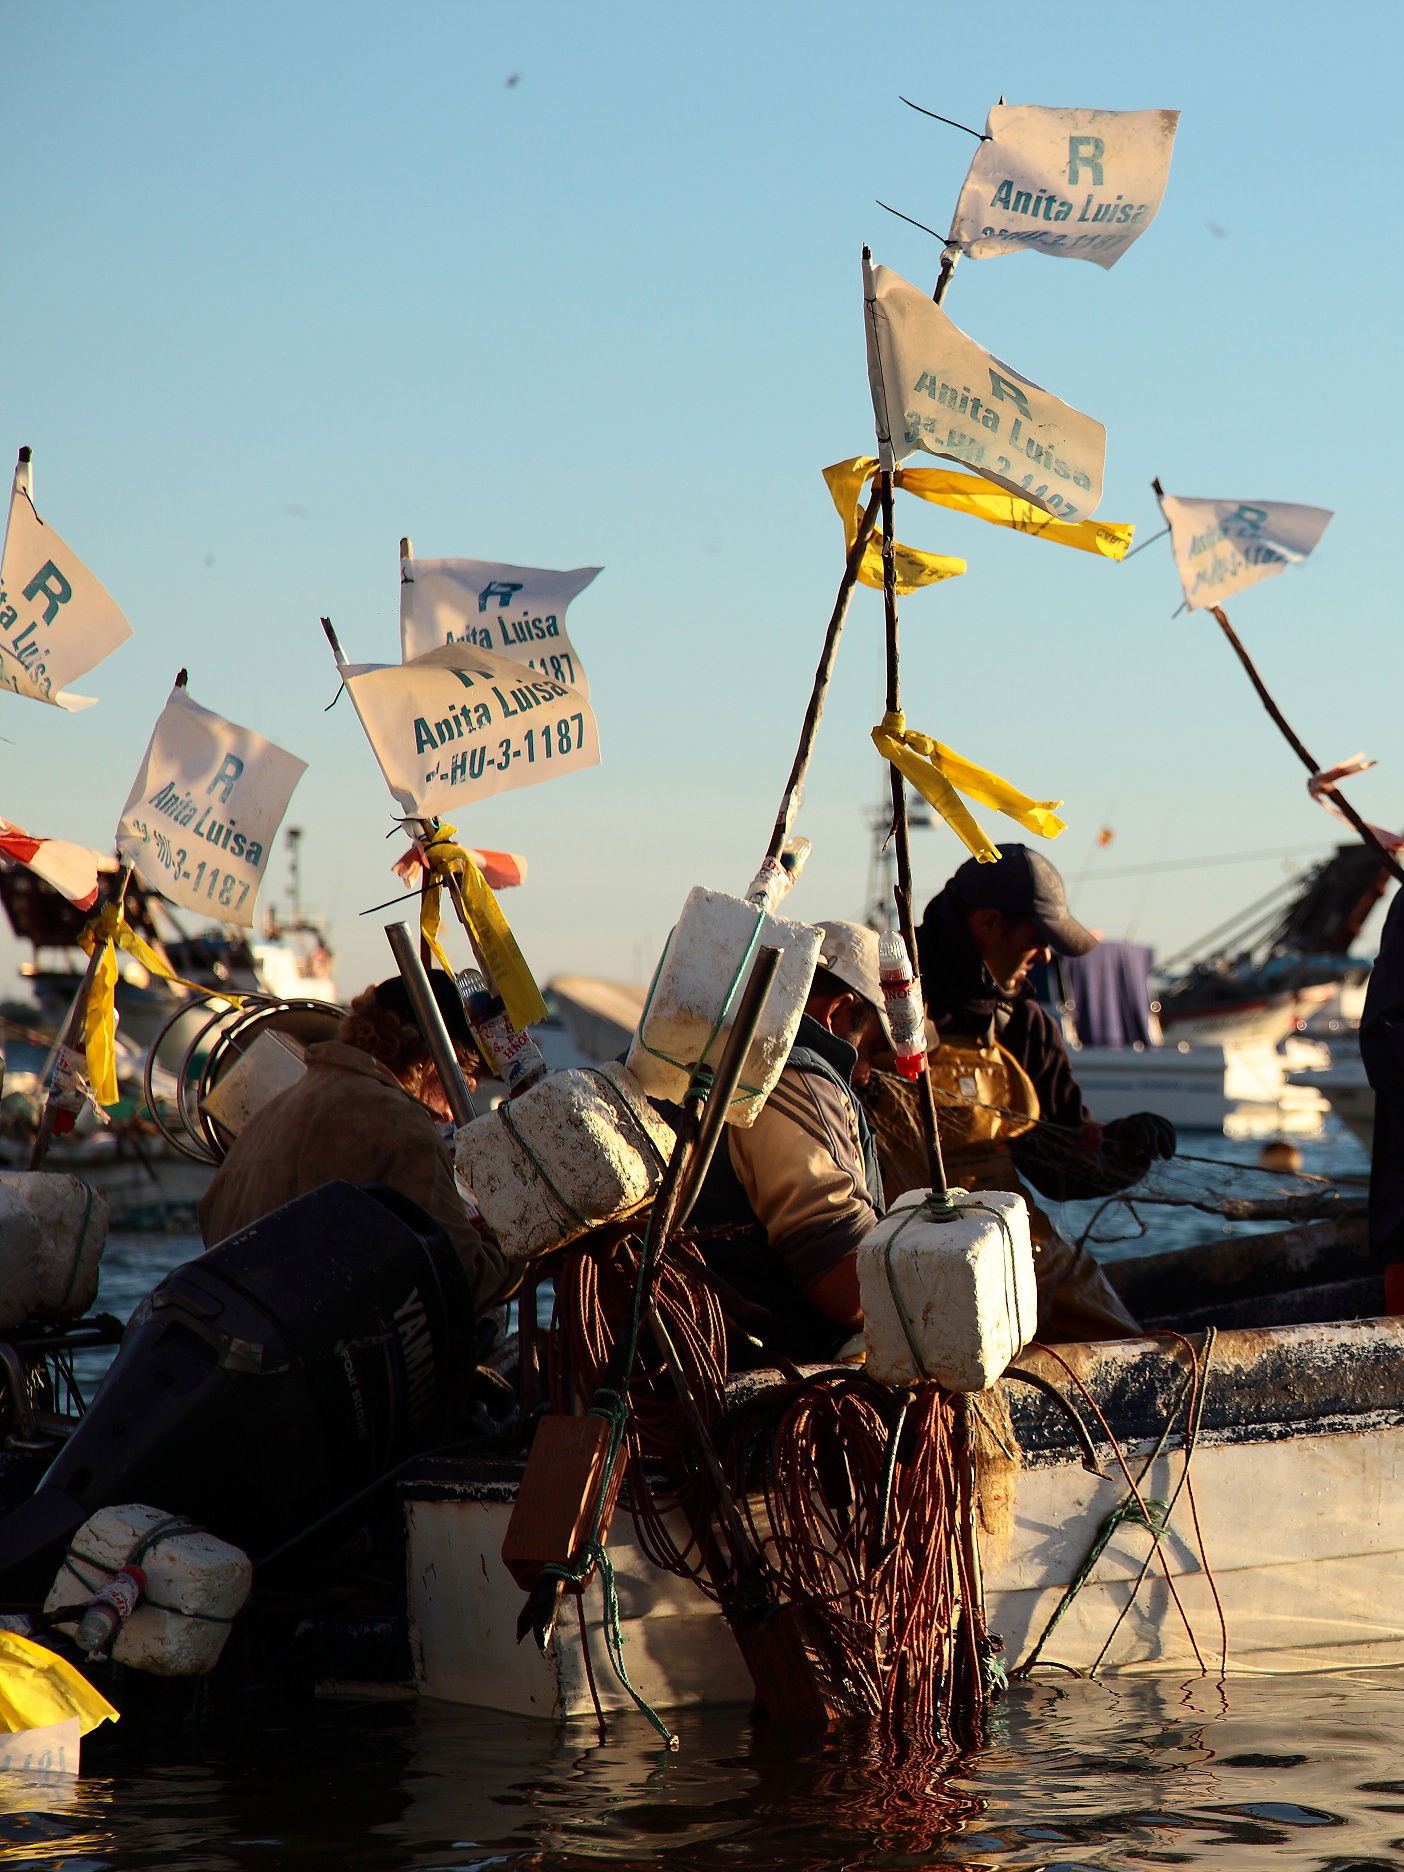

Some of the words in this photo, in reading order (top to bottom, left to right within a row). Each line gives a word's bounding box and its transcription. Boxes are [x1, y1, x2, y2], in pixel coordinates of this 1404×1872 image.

[1067, 135, 1105, 187] R
[989, 179, 1074, 223] Anita
[1077, 193, 1149, 225] Luisa
[988, 367, 1033, 422] R
[913, 369, 1001, 434] Anita
[1008, 417, 1092, 493] Luisa
[22, 559, 72, 627] R
[477, 580, 525, 614] R
[446, 625, 493, 651] Aita
[496, 611, 561, 647] Luisa
[413, 702, 493, 756] Anita
[490, 679, 569, 719] Luisa
[206, 752, 245, 804] R
[149, 780, 198, 828] Anita
[192, 806, 264, 868] Luisa
